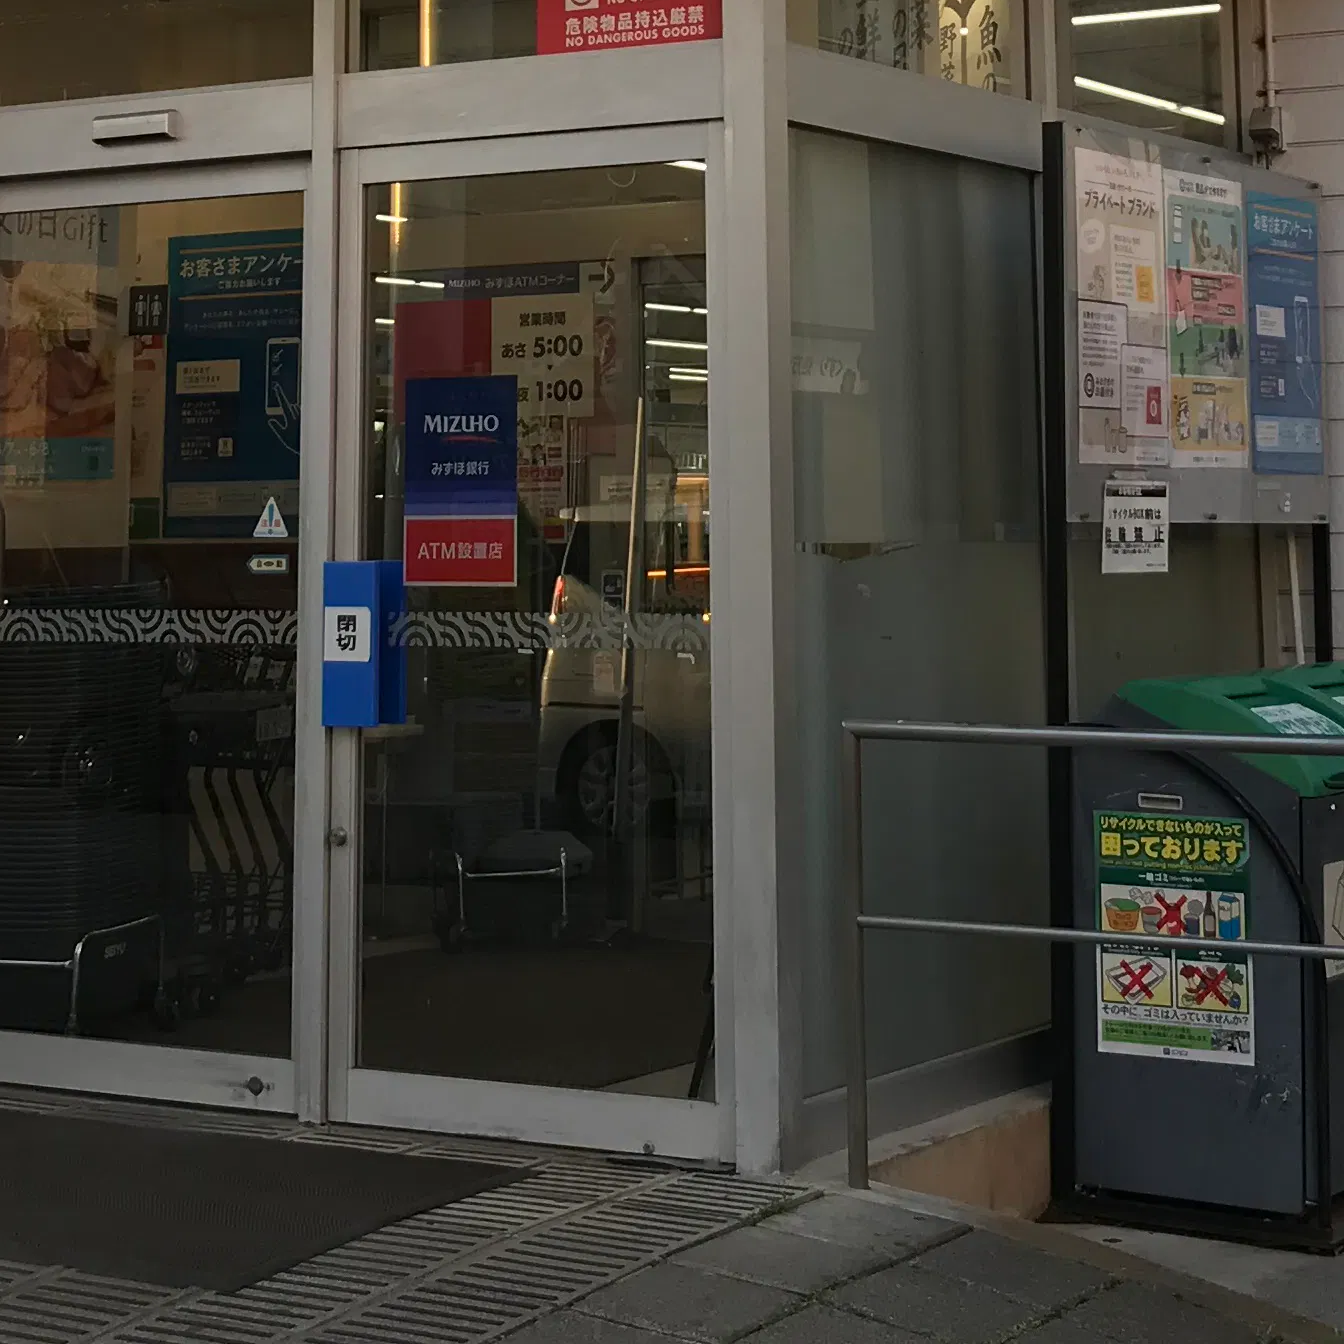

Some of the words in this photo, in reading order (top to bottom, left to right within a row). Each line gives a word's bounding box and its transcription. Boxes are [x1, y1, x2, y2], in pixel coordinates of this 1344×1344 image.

[565, 5, 704, 36] 危険物品持込厳禁
[565, 36, 584, 47] NO
[588, 29, 658, 45] DANGEROUS
[662, 25, 705, 38] GOODS
[519, 311, 566, 327] 営業時間
[423, 414, 500, 434] MIZUHO
[430, 460, 490, 476] みずほ銀行
[417, 542, 504, 560] ATM設置店
[1100, 815, 1243, 837] リサイクルできないものが入って
